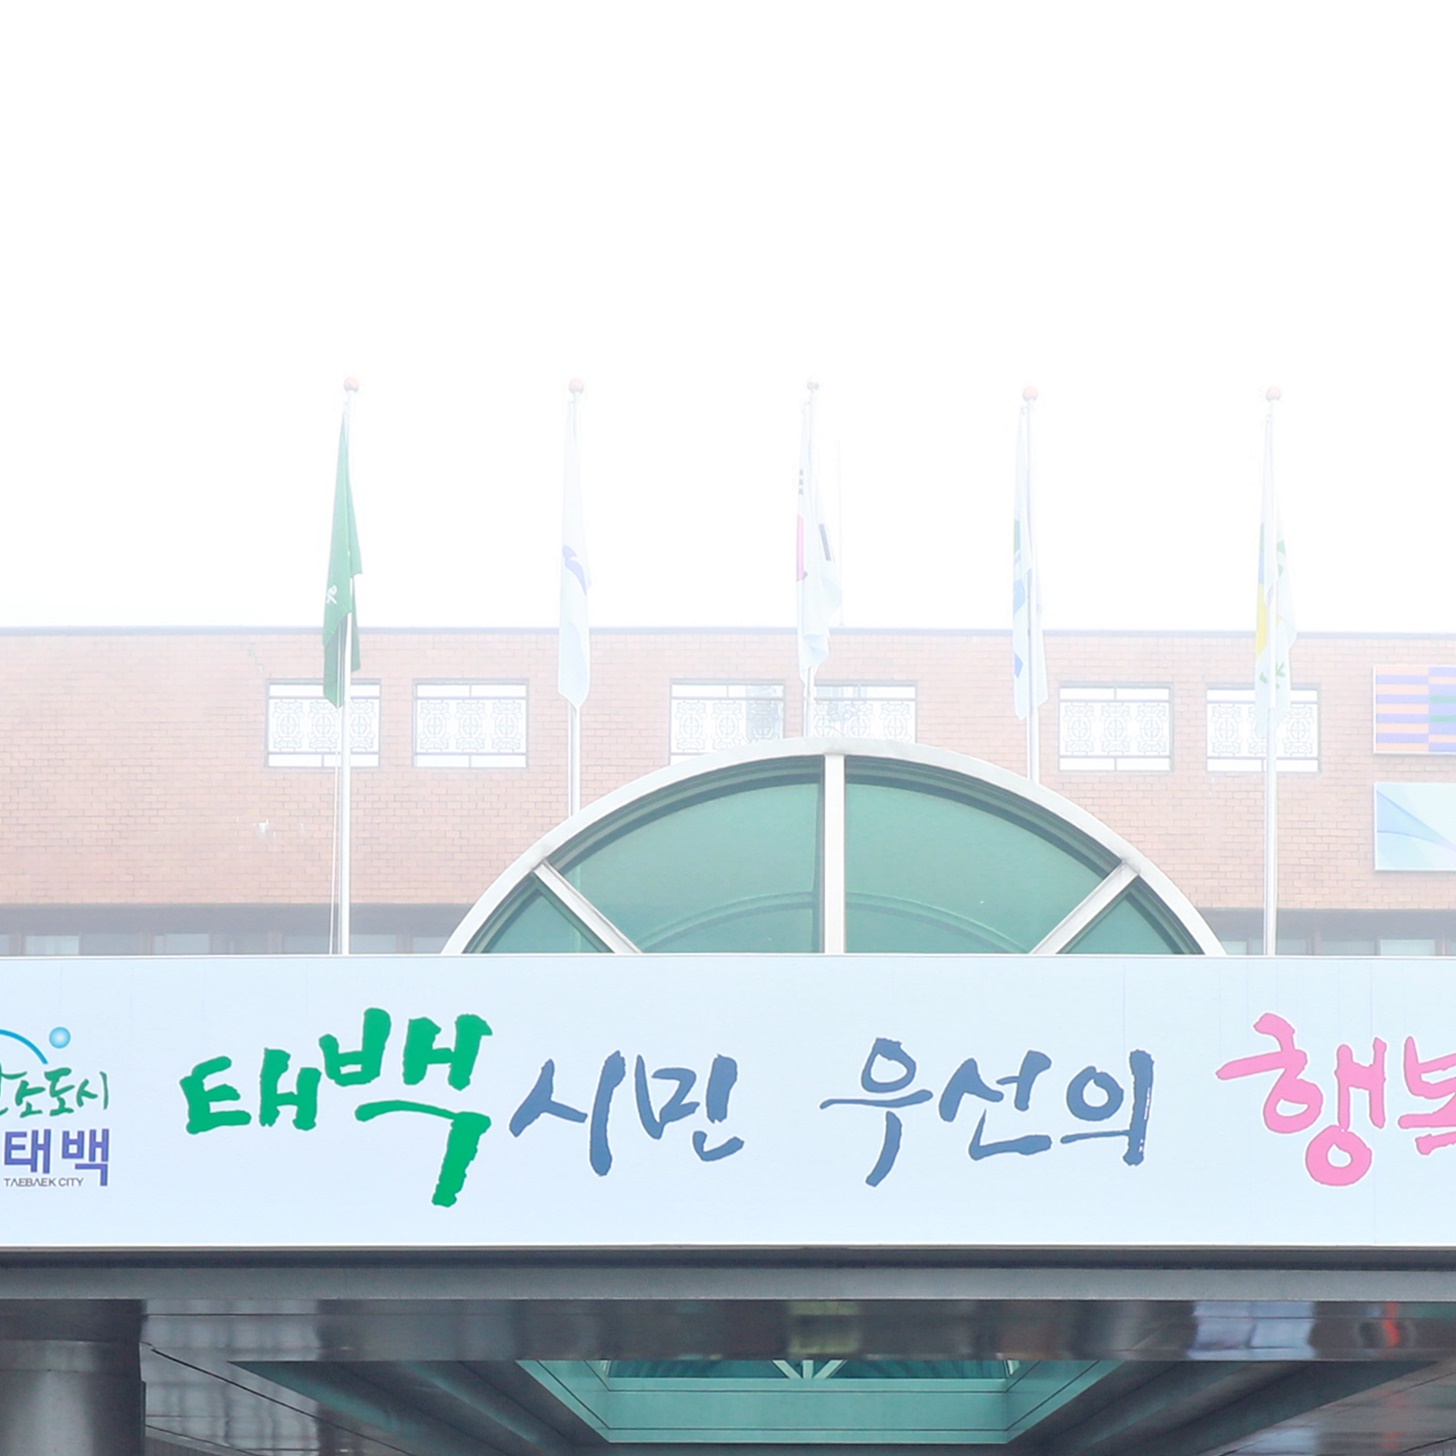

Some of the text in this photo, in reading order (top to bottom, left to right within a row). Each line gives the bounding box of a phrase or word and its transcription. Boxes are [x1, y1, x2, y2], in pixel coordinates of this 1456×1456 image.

[820, 1037, 1155, 1188] 우선의
[3, 1177, 85, 1187] TAEBAEK CITY
[4, 1128, 110, 1187] 태백
